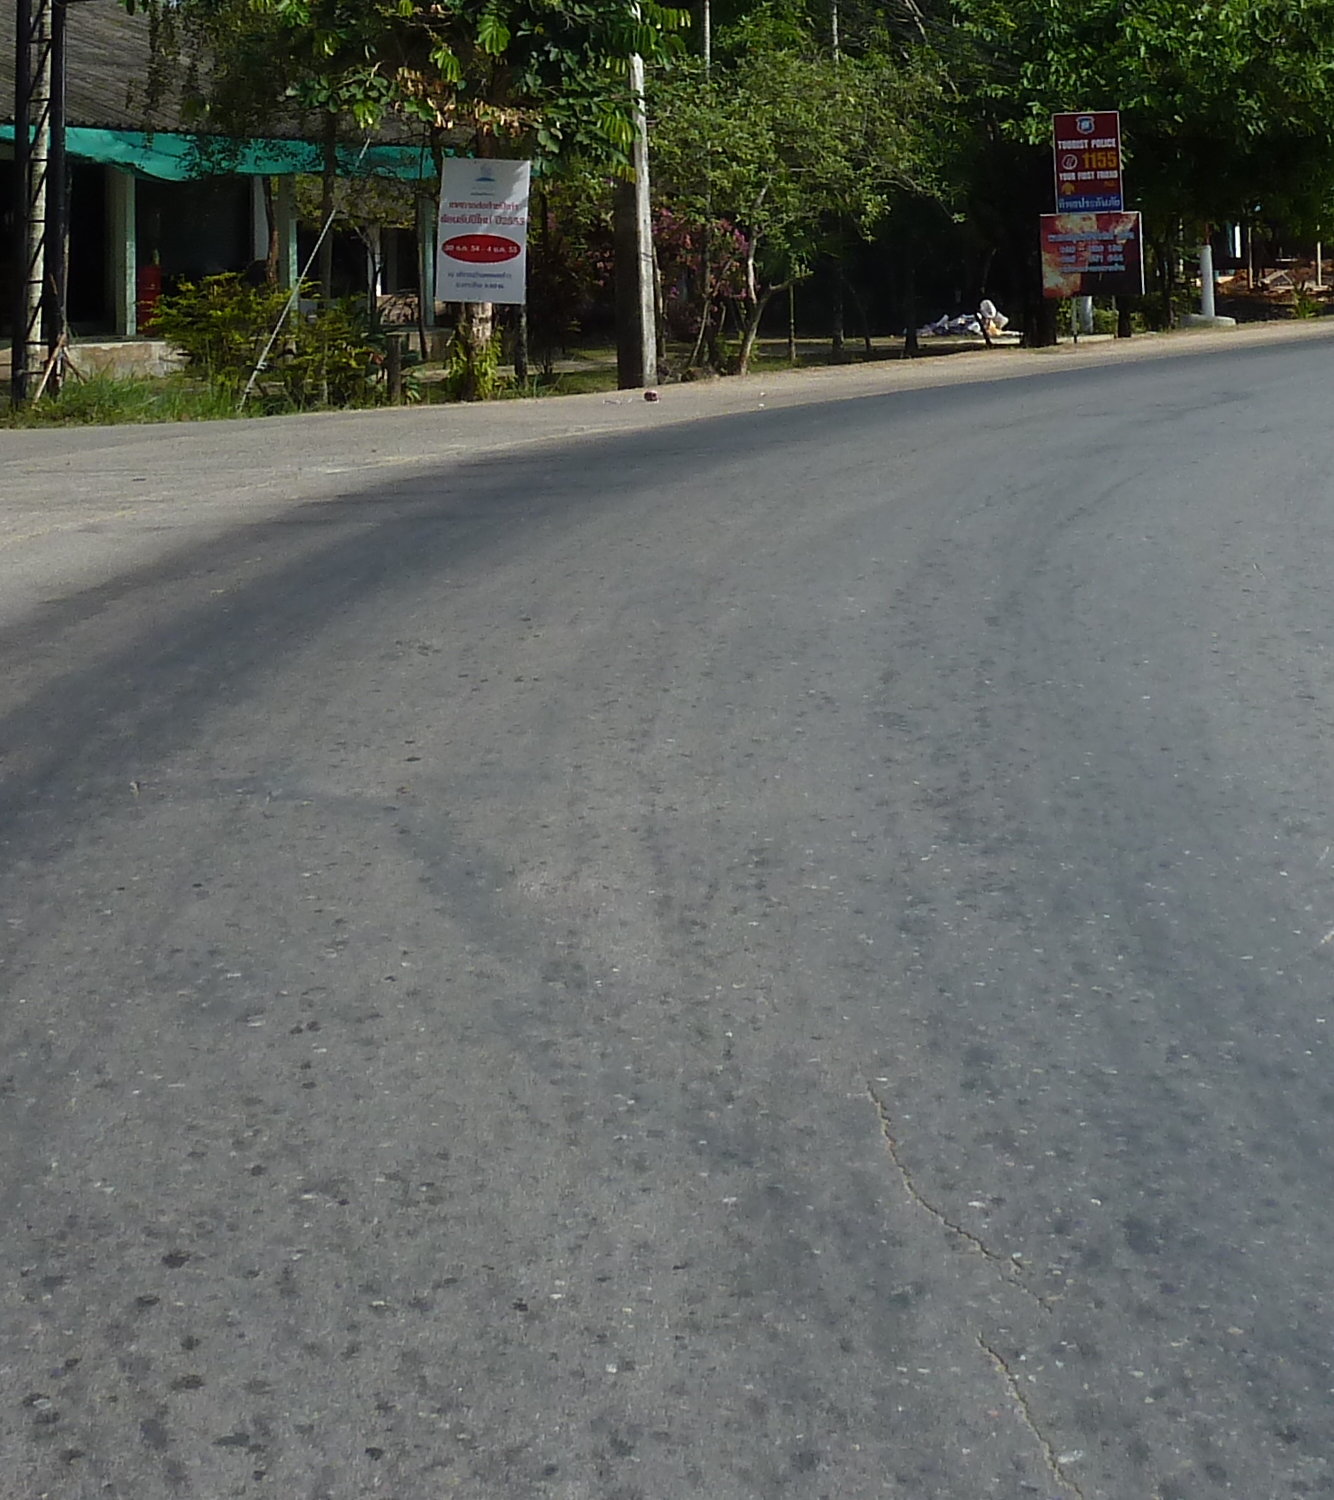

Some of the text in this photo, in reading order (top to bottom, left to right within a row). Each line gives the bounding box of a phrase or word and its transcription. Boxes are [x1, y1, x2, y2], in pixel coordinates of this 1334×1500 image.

[1057, 138, 1116, 150] TOURIST POLICE
[1082, 151, 1118, 169] 1155
